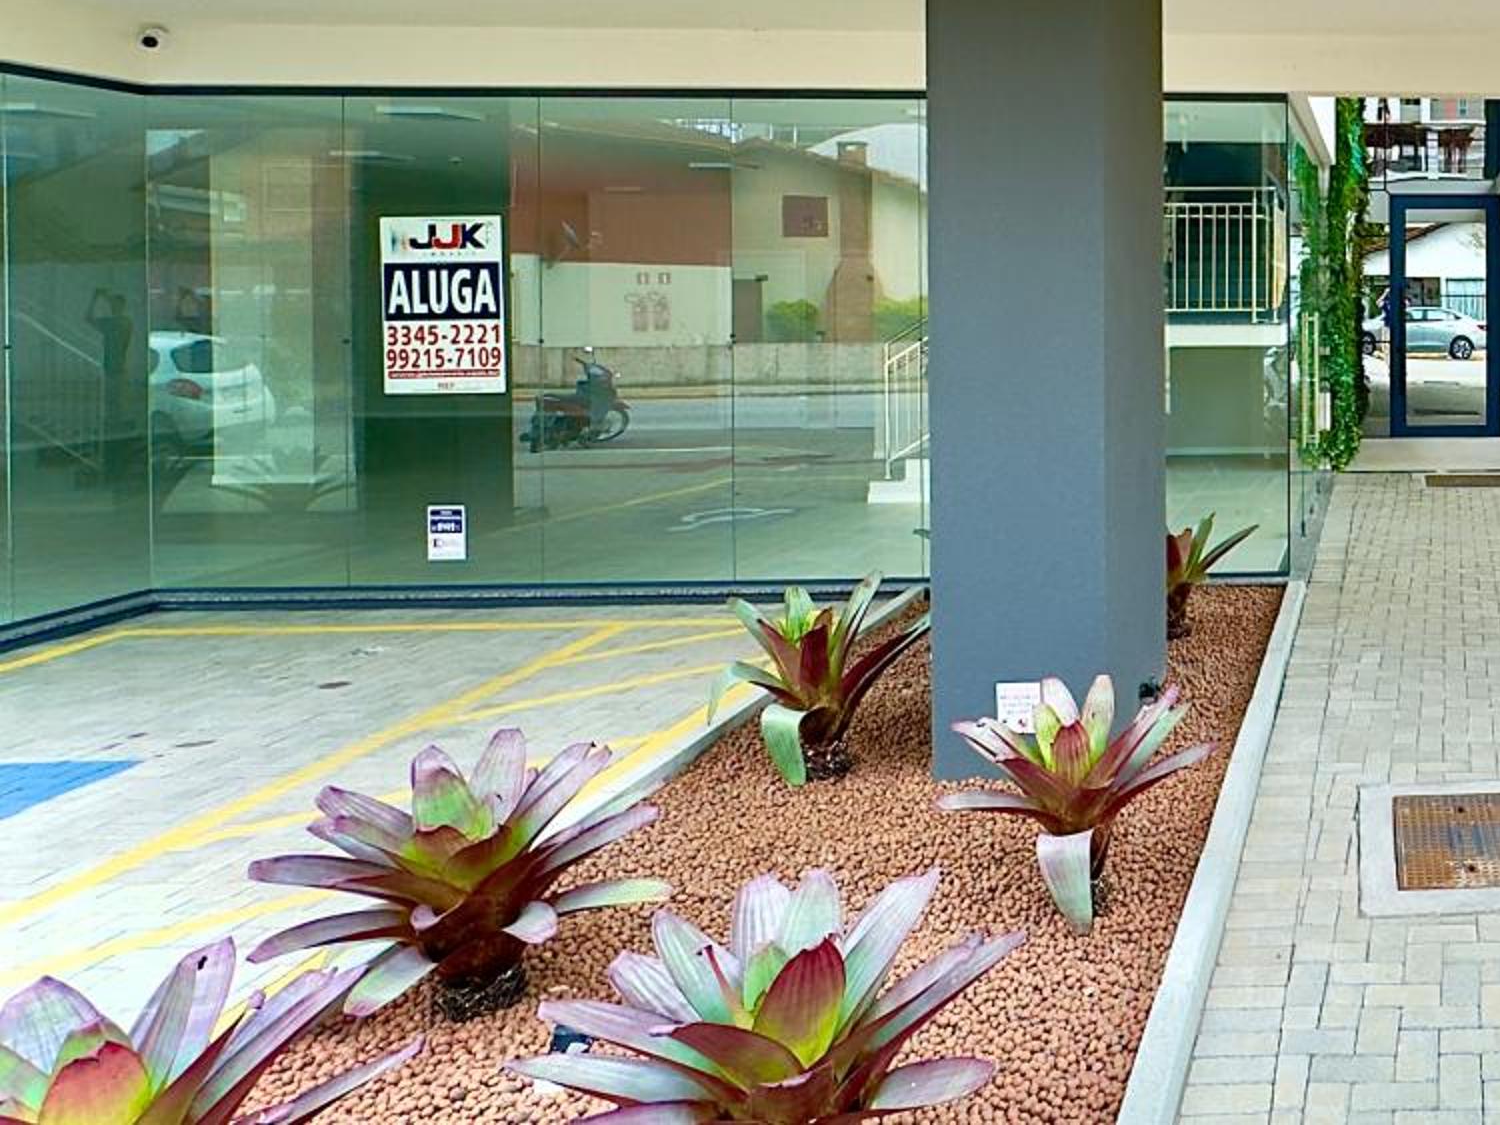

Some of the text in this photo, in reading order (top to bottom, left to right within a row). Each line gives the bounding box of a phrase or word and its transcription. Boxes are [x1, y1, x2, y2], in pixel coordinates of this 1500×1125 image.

[408, 222, 485, 249] JJK
[387, 268, 497, 314] ALUGA
[387, 324, 500, 346] 3345-2221
[386, 346, 501, 369] 99215-7109
